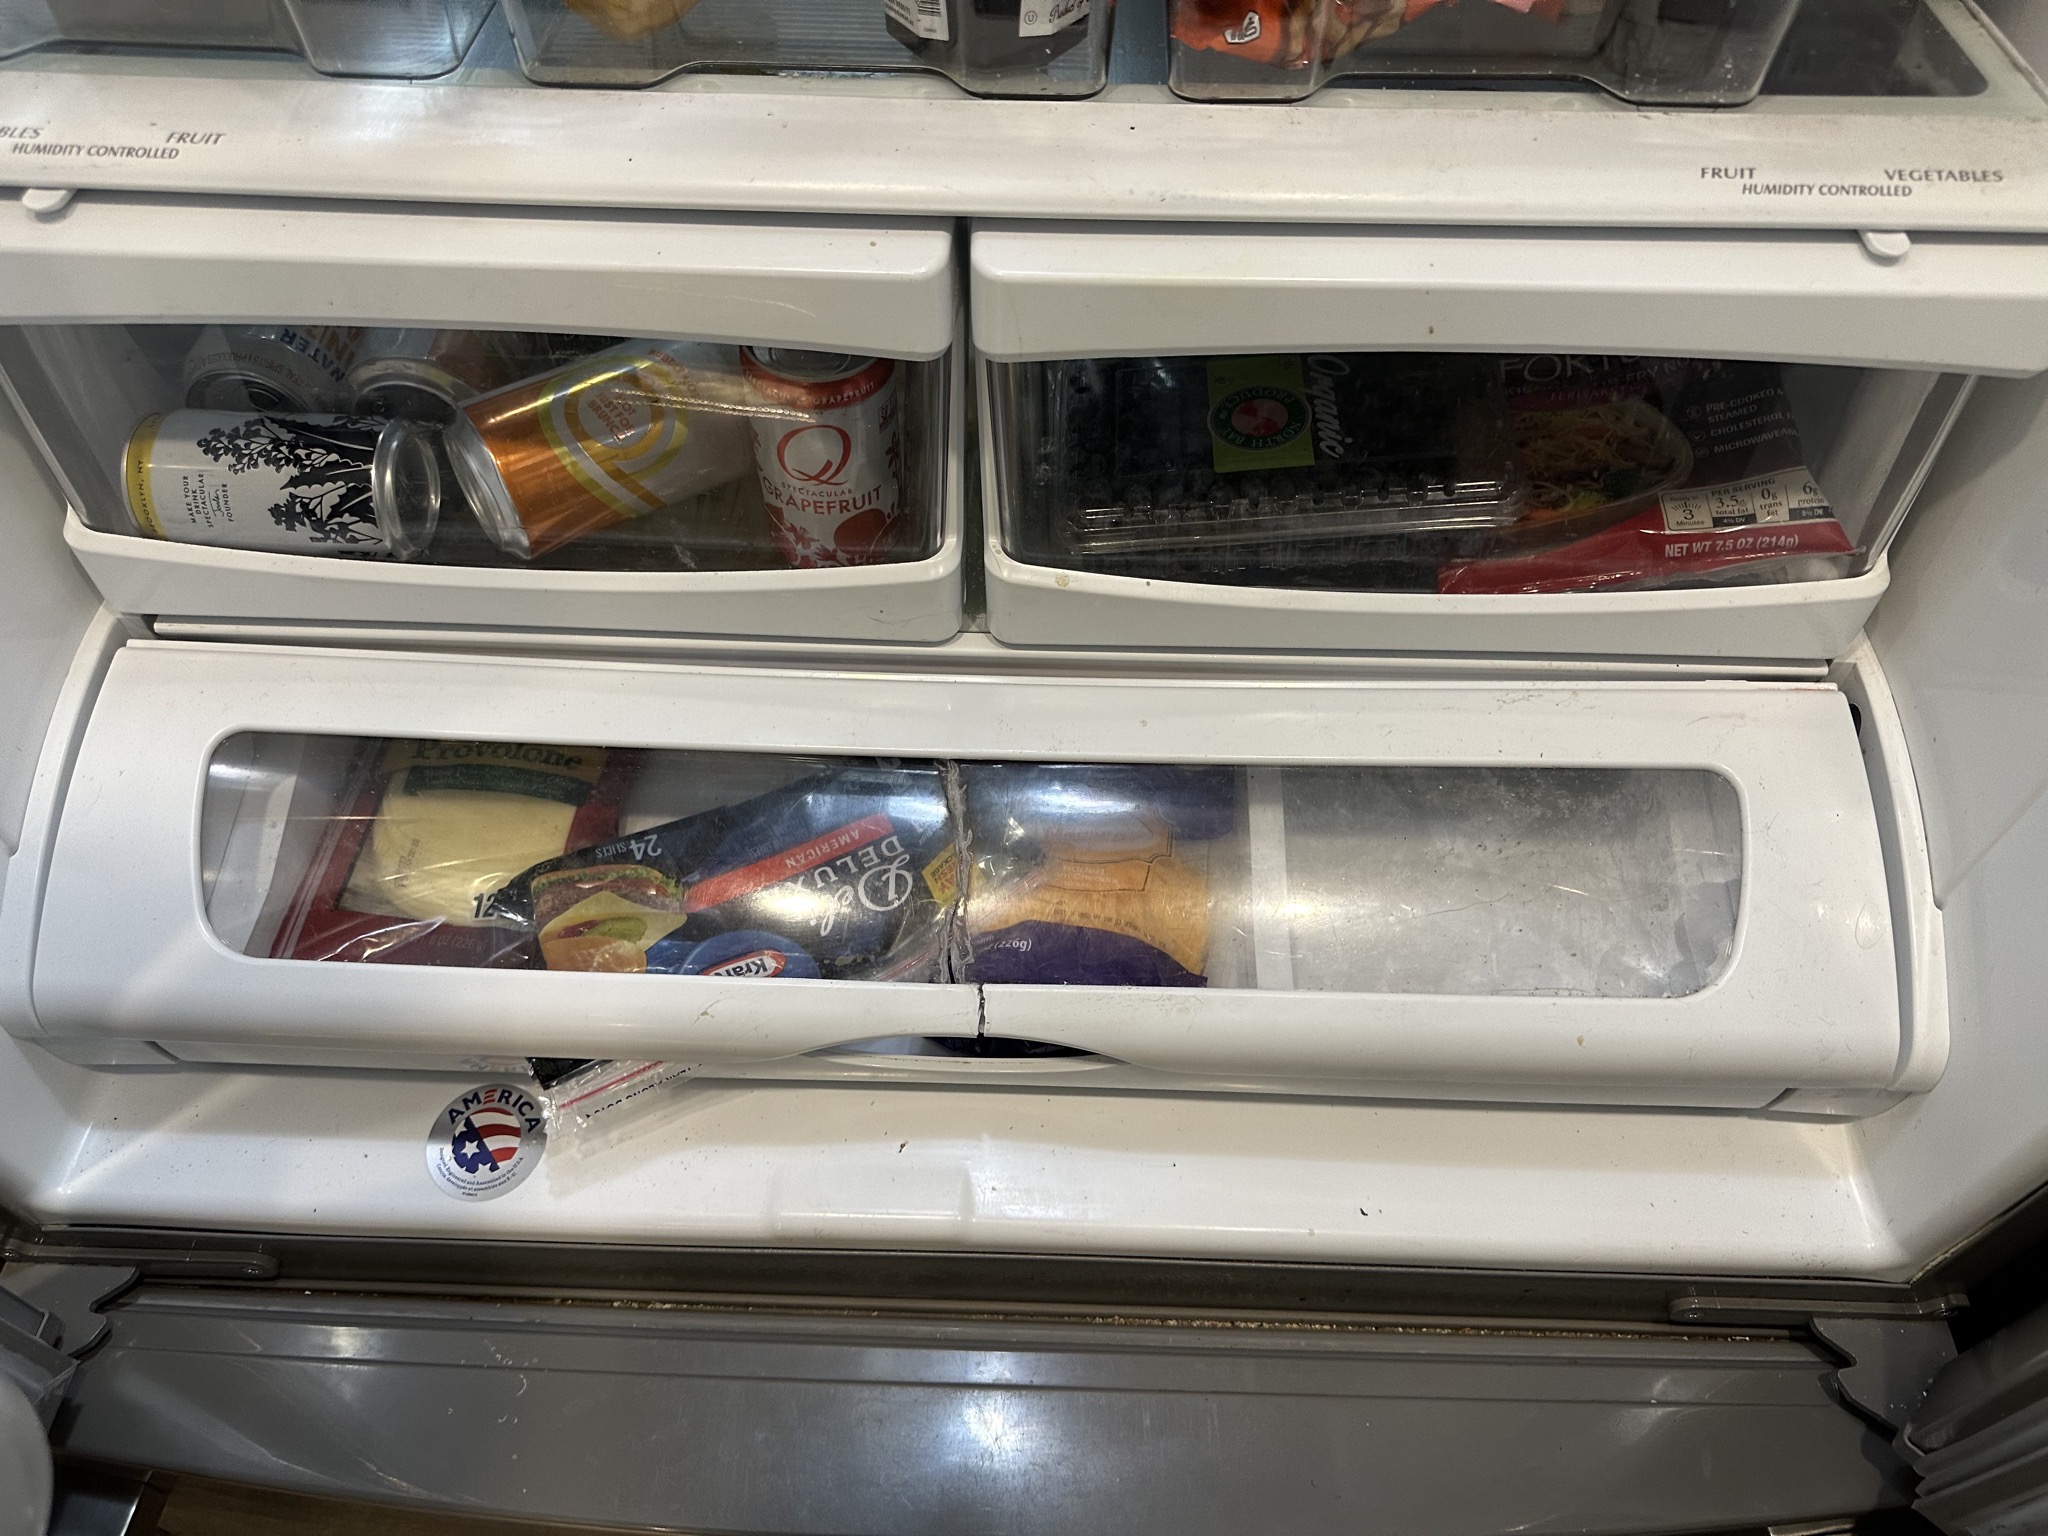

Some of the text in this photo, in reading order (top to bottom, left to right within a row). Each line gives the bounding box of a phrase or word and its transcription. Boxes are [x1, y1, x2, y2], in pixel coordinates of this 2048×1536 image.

[0, 127, 43, 139] BLES
[166, 132, 226, 145] FRUIT
[12, 143, 180, 159] HUMIDITY CONTROLLED
[1701, 167, 1756, 179] FRUIT
[1884, 169, 2004, 182] VEGETABLES
[1742, 183, 1912, 197] HUMIDITY CONTROLLED
[1500, 354, 1640, 382] FOR
[1225, 388, 1294, 410] PRODUCE
[1303, 354, 1354, 459] Organic
[1706, 388, 1774, 412] PRE-COOKED
[587, 400, 625, 443] BRUNC
[1707, 404, 1758, 423] STEAMED
[1710, 411, 1785, 437] CHOLESTEROL
[1222, 421, 1302, 448] NORTH BAY
[137, 460, 144, 474] NY
[777, 424, 852, 486] Q
[183, 475, 197, 524] MAKE YOUR
[762, 476, 882, 515] GRAPEFRUIT
[781, 482, 854, 498] SPECTACULAR
[1711, 477, 1776, 498] PER SERVING
[1761, 487, 1779, 501] 0g
[1802, 481, 1819, 496] 6g
[191, 489, 202, 515] DRINK
[198, 473, 214, 528] SPECTACULAR
[222, 483, 235, 522] FOUNDER
[1737, 506, 1750, 514] fat
[1760, 501, 1783, 511] trans
[1676, 519, 1705, 527] Minutes
[1682, 509, 1694, 521] 3
[1766, 509, 1779, 517] fat
[1665, 534, 1799, 558] NET WT 7.5 OZ (214g)
[409, 740, 583, 770] Provolone
[595, 834, 662, 860] 24 SLICES
[785, 828, 860, 867] AMERICAN
[787, 835, 904, 888] DELU
[931, 854, 955, 878] CKAGE
[473, 893, 496, 918] 12
[810, 853, 913, 936] Deli
[714, 958, 768, 977] Kra
[448, 1088, 541, 1134] AMERICA
